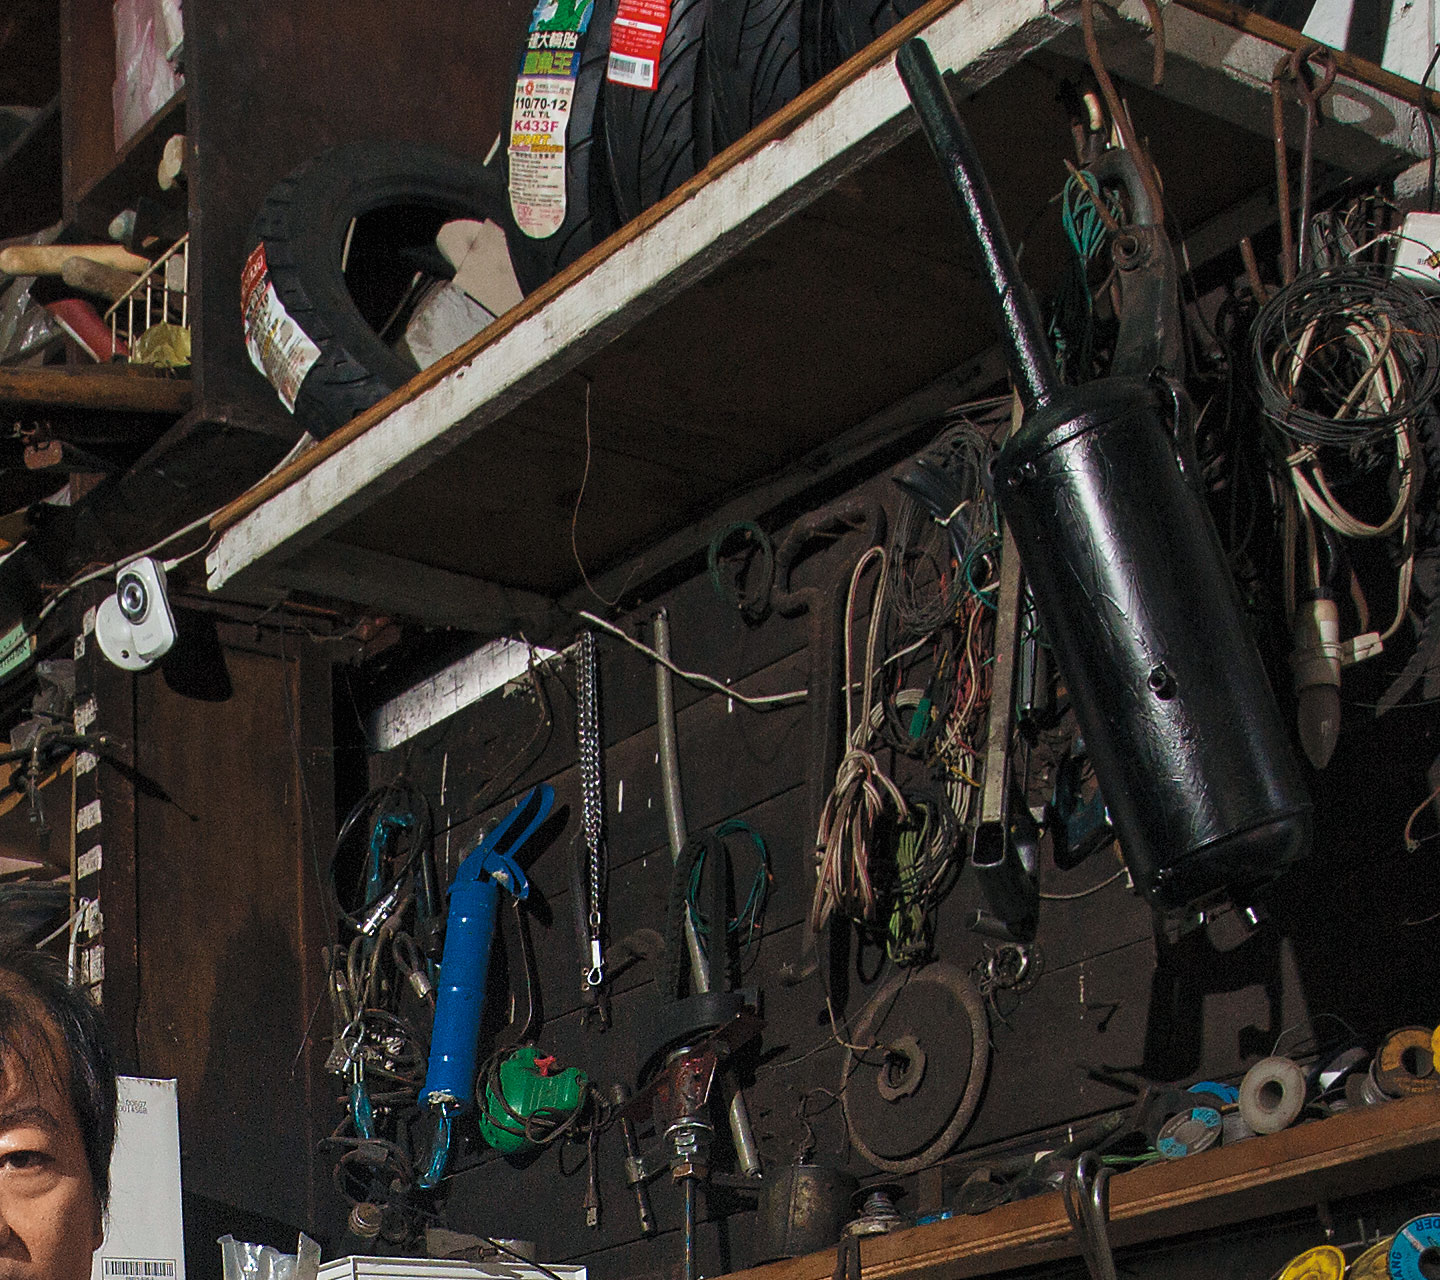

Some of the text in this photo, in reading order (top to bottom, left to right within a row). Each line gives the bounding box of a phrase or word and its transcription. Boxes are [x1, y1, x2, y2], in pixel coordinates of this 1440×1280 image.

[528, 32, 578, 49] 建大輪胎
[515, 96, 567, 112] 110/70-12
[514, 120, 558, 132] K433F
